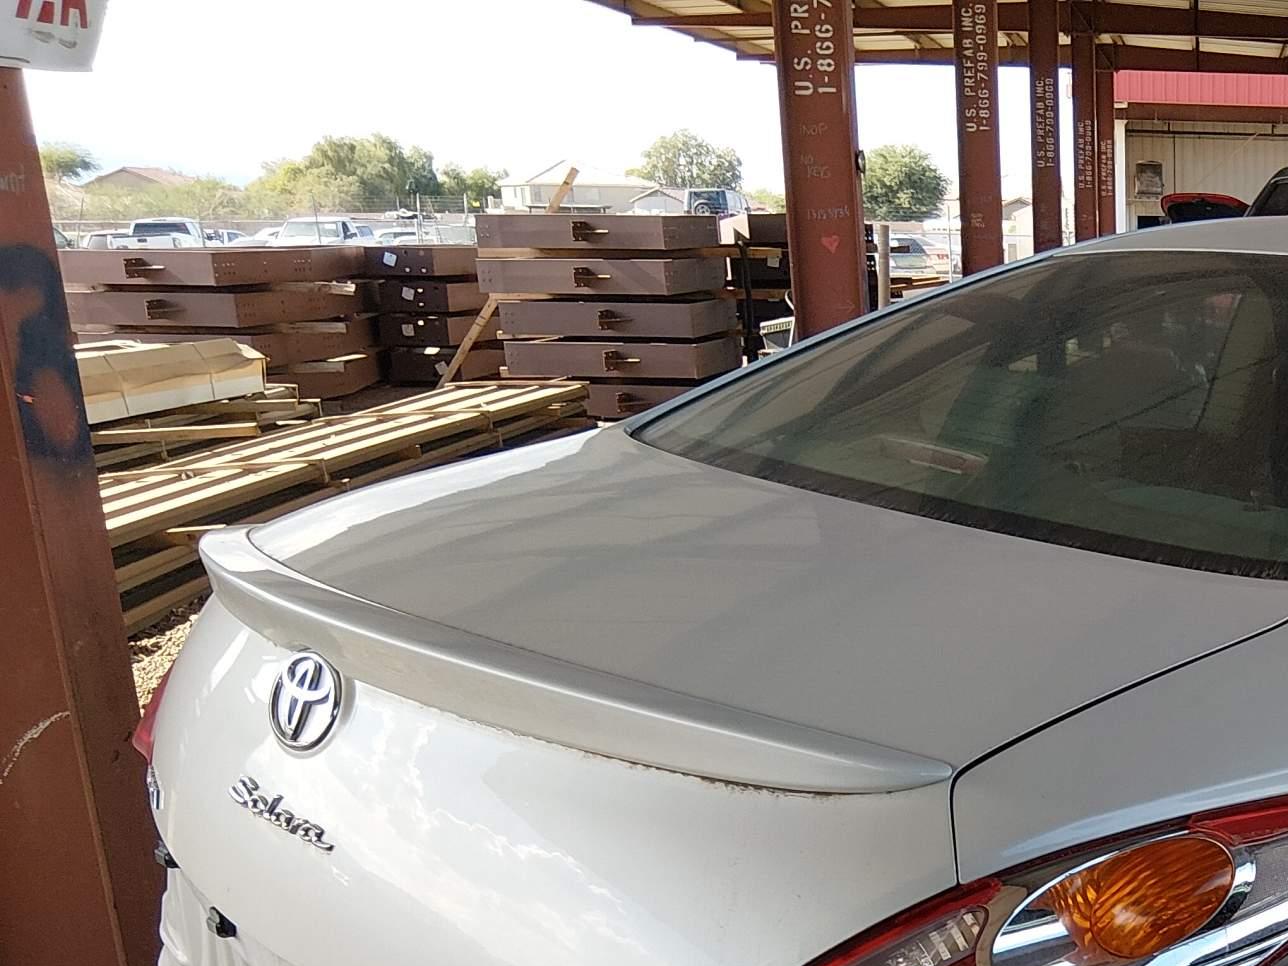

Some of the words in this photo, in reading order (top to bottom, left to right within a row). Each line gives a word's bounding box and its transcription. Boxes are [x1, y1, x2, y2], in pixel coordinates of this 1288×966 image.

[961, 3, 974, 31] INC.
[793, 50, 814, 95] U.S.
[962, 39, 976, 96] PREFAB
[975, 4, 991, 131] 1-866-799-0969
[965, 104, 977, 131] U.S.
[228, 775, 335, 851] Solara
